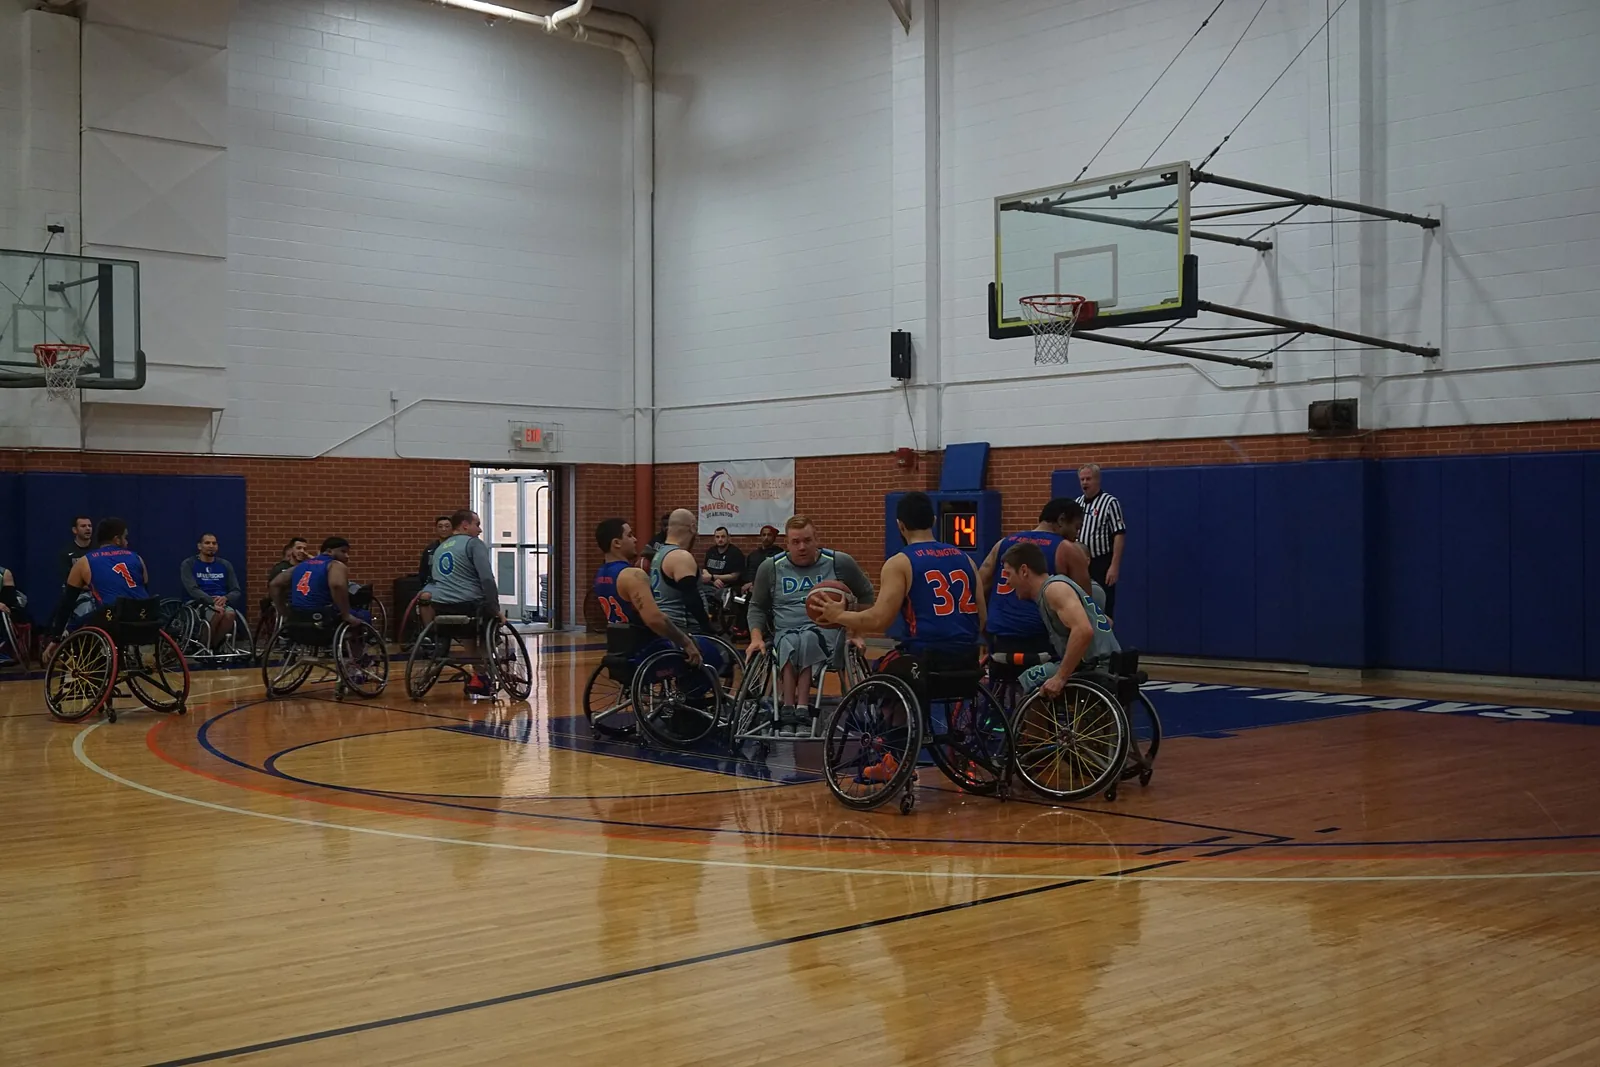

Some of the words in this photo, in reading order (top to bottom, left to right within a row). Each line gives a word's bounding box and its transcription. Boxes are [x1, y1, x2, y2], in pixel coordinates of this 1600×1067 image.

[526, 428, 541, 442] EXIT
[700, 501, 740, 514] MAVERICKS
[954, 514, 975, 547] 14
[437, 551, 455, 577] 0
[914, 549, 926, 557] UT
[926, 548, 962, 557] ARLINGTON
[112, 562, 137, 588] 1
[296, 571, 312, 596] 4
[924, 569, 978, 616] 32
[1246, 690, 1574, 720] MAVS
